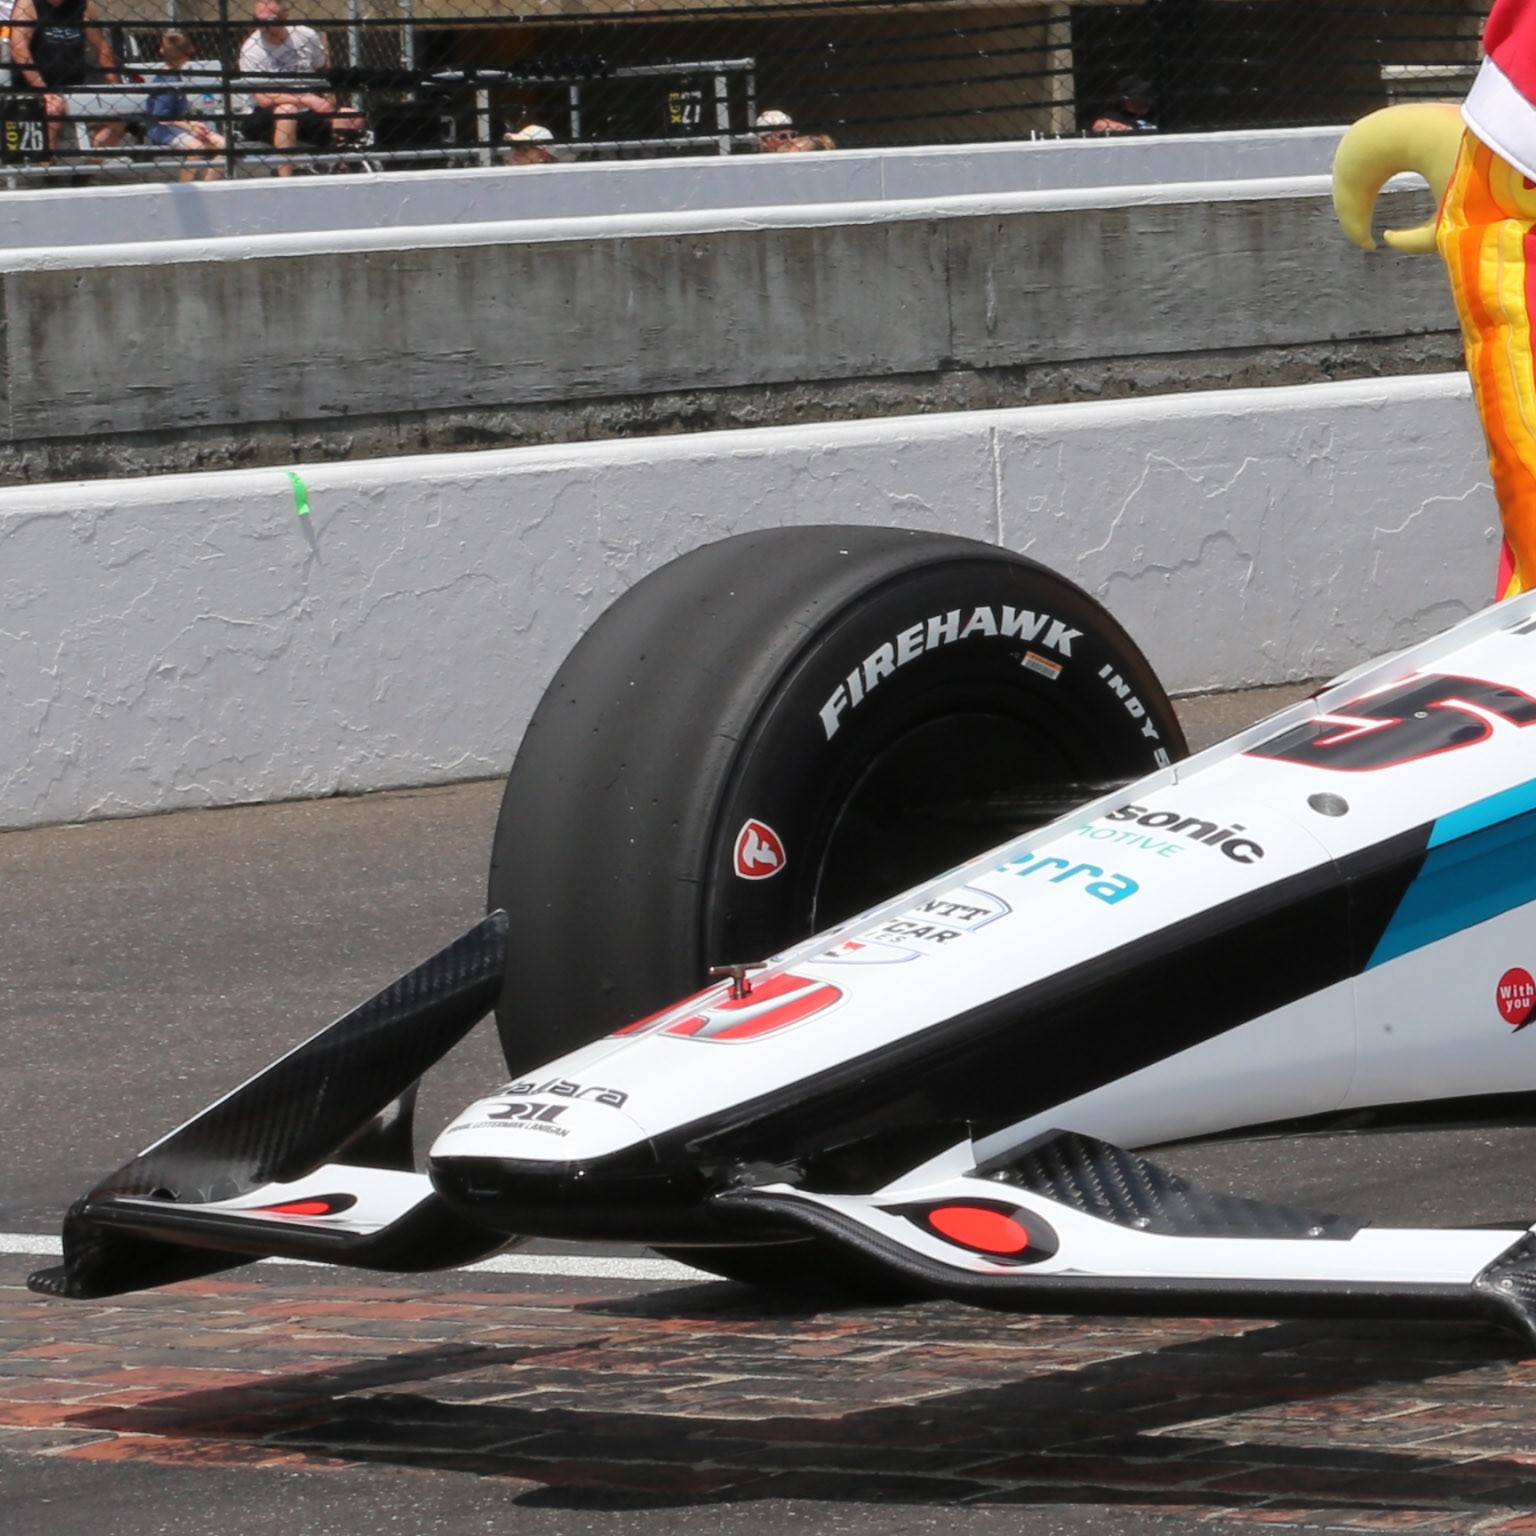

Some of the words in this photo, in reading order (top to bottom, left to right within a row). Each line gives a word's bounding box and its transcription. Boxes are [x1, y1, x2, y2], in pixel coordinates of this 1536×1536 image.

[681, 91, 702, 124] 27
[19, 121, 44, 151] 26
[818, 604, 1085, 742] FIREHAWK
[1098, 663, 1161, 742] INDY
[1106, 803, 1266, 865] sonic
[1500, 983, 1534, 1000] With
[1505, 997, 1531, 1013] you
